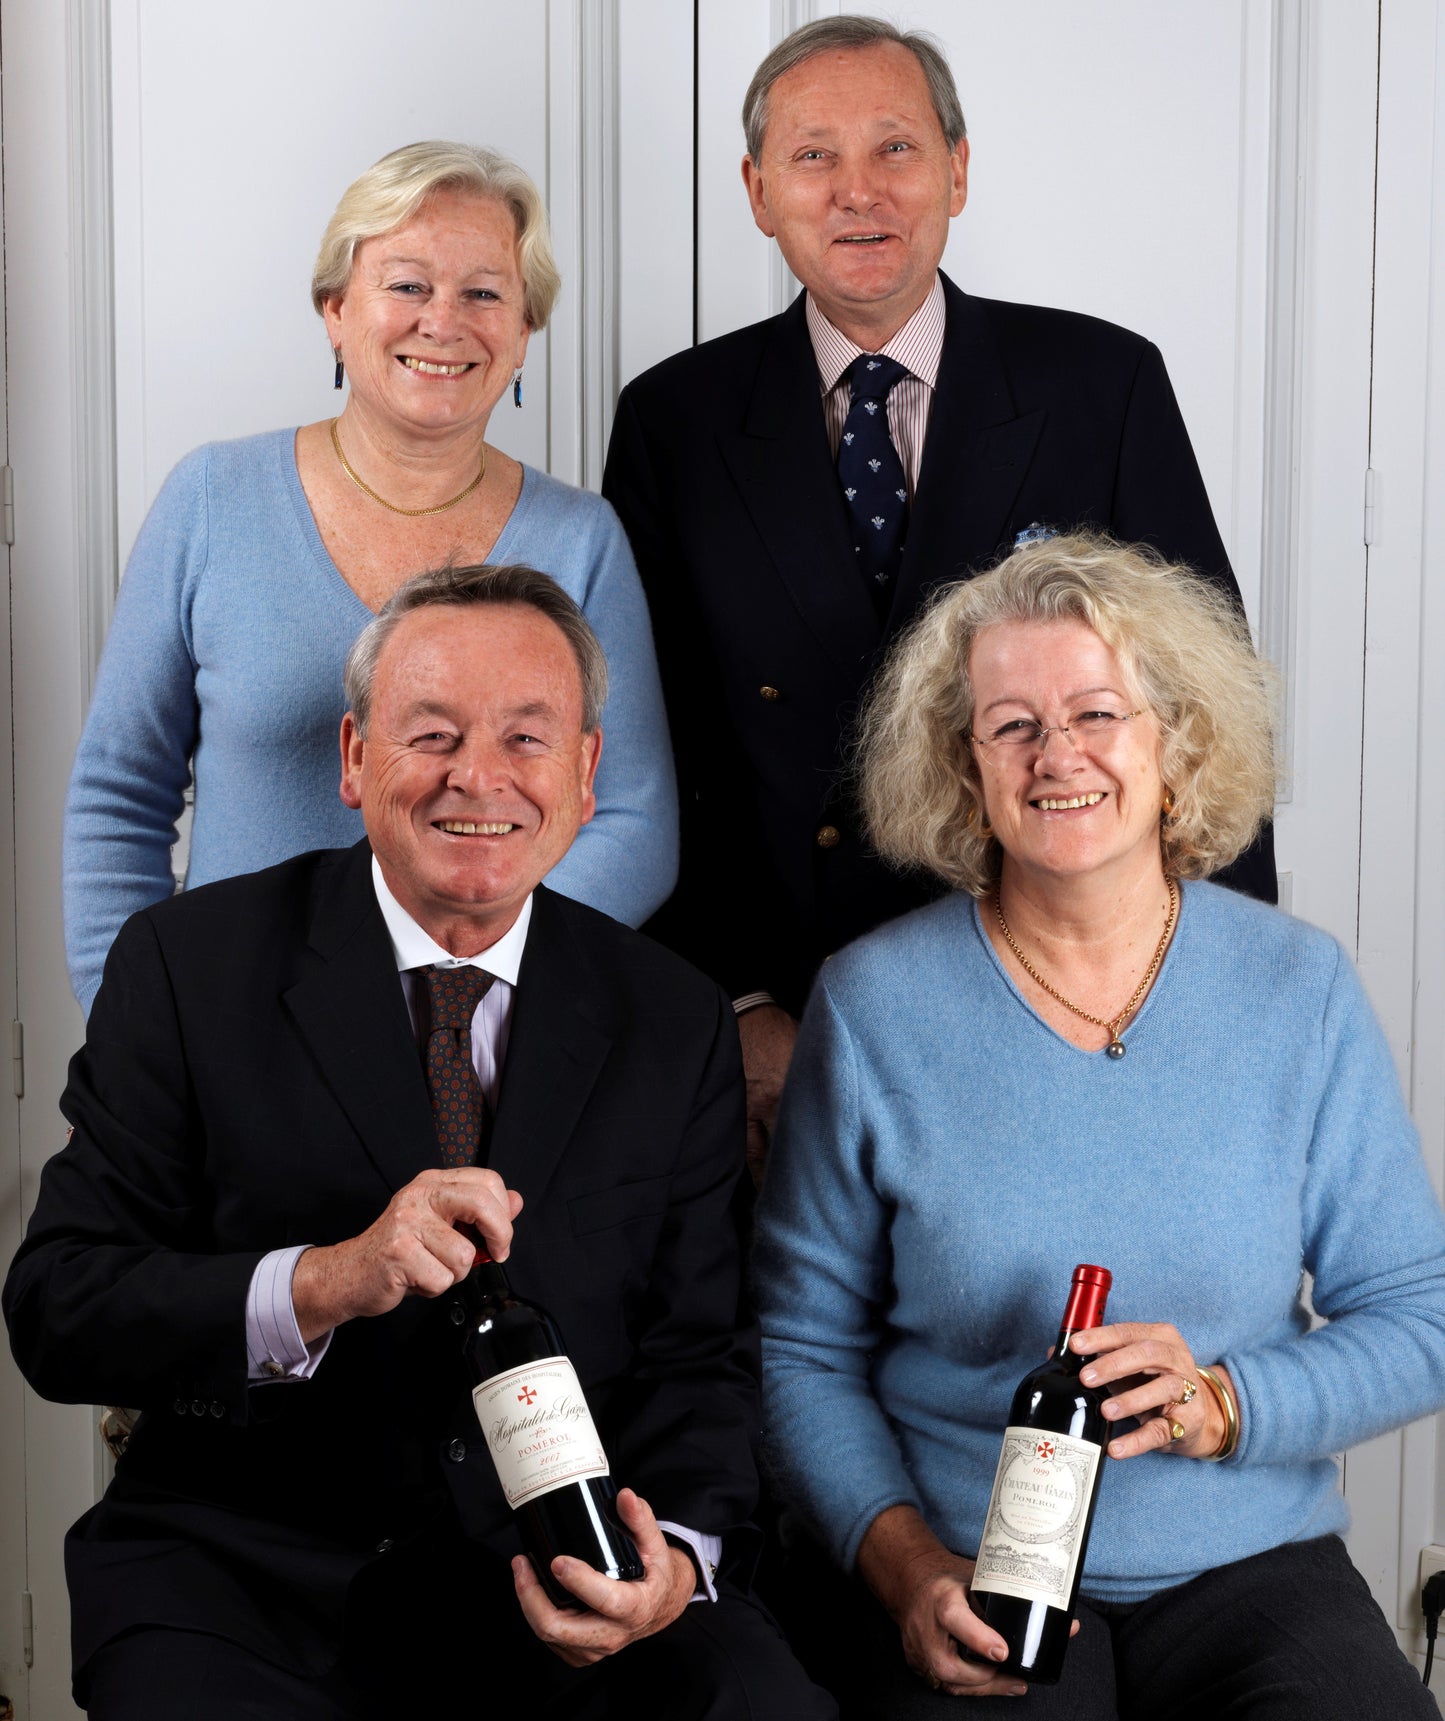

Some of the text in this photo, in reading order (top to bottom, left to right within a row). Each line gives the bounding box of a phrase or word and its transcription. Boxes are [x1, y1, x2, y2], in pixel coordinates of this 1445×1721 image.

[489, 1408, 546, 1452] Hospitalet
[546, 1410, 556, 1420] de
[518, 1433, 571, 1457] POMEROL
[539, 1453, 561, 1465] 2007
[1033, 1467, 1050, 1477] 1999
[1013, 1493, 1056, 1508] POMEROL
